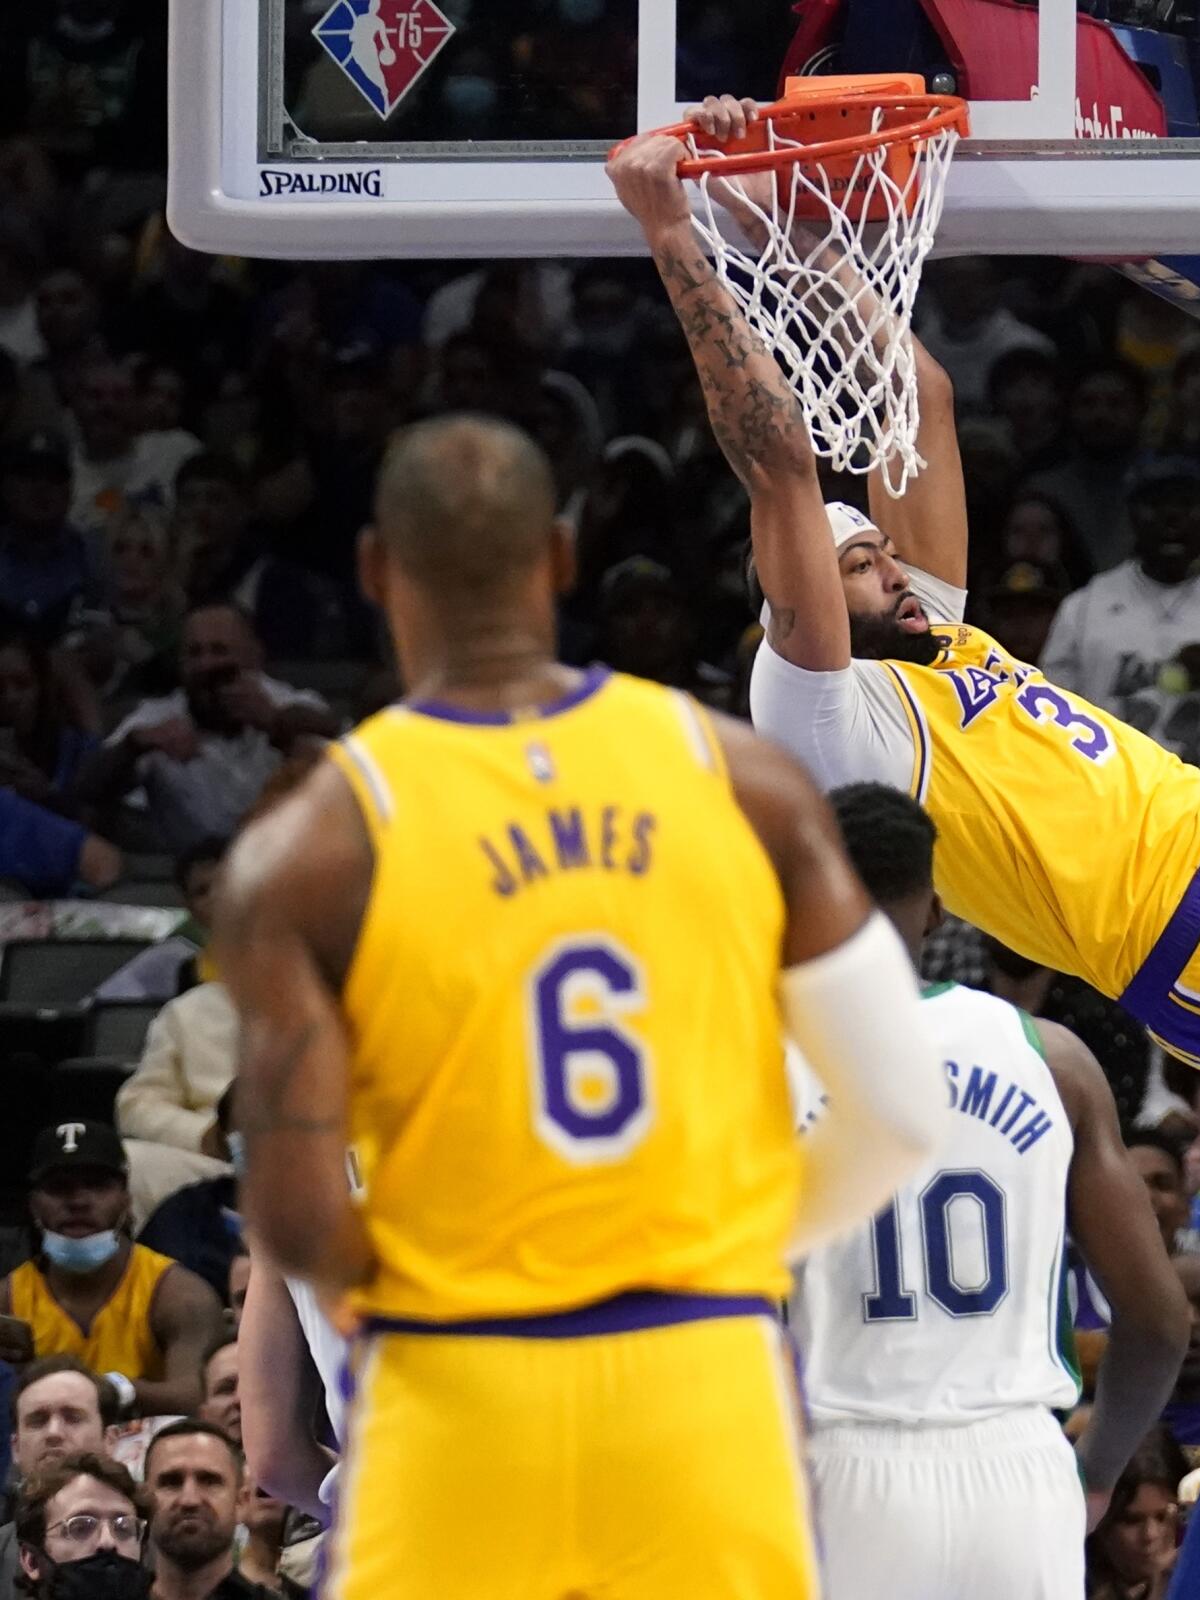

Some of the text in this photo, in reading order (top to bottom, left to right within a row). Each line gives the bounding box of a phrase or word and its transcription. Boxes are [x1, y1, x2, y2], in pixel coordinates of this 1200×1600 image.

[396, 13, 422, 48] 75
[260, 169, 384, 197] SPALDING
[1015, 682, 1113, 764] 3
[478, 805, 656, 898] JAMES
[526, 935, 653, 1163] 6
[56, 1122, 86, 1153] T
[862, 1167, 1010, 1323] 10
